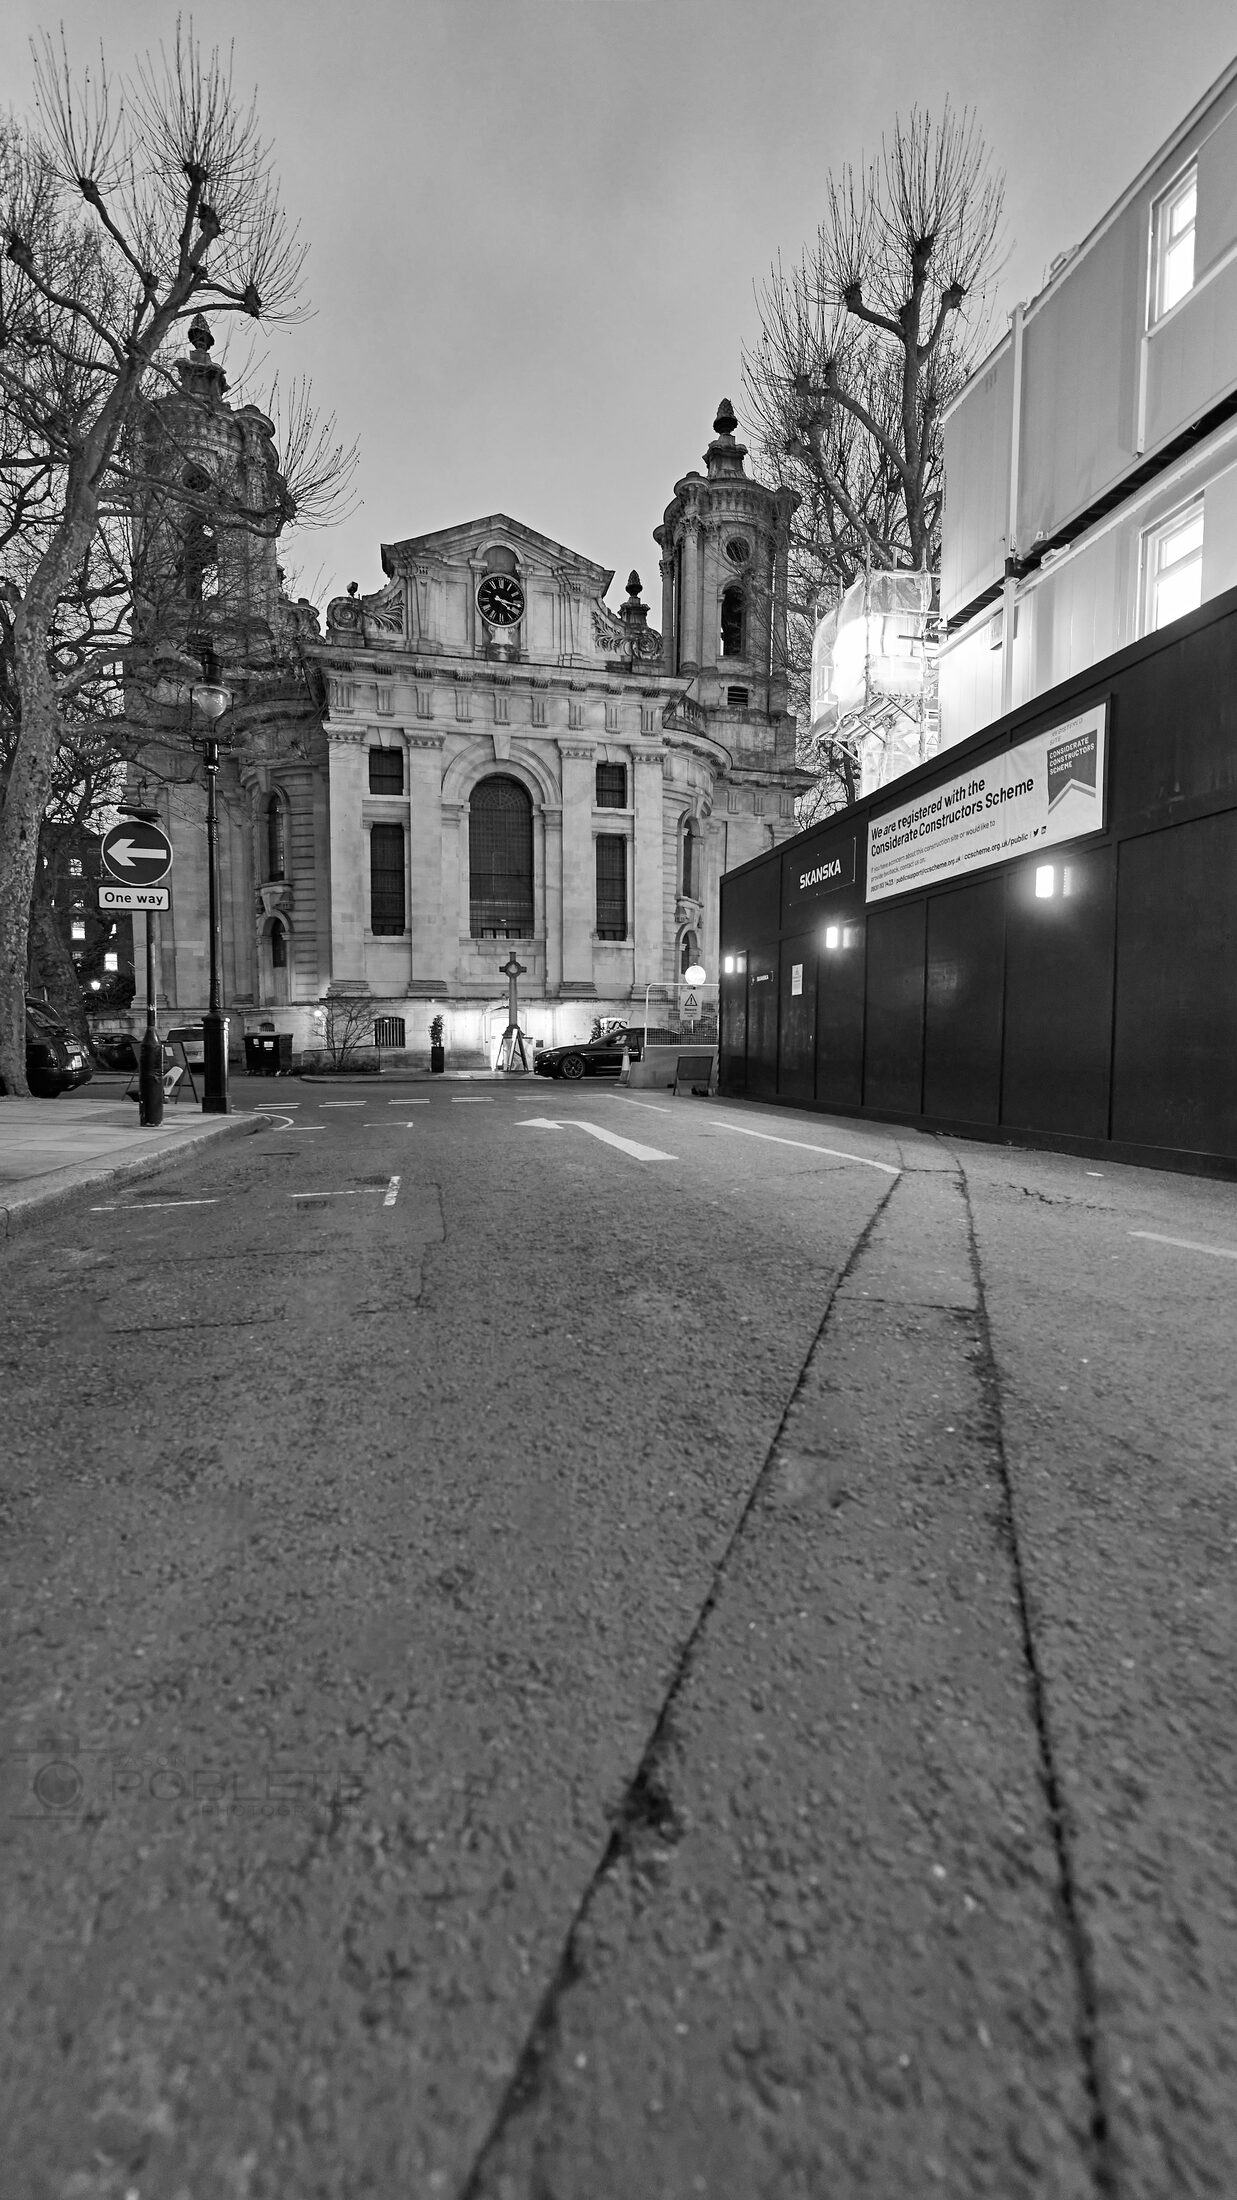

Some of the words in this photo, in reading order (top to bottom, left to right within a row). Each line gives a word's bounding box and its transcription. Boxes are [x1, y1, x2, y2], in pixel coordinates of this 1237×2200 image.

[1049, 736, 1089, 760] CONSIDERATE
[1049, 742, 1095, 767] CONSTRUCTORS
[1049, 760, 1073, 776] SCHEME
[871, 827, 882, 841] We
[883, 822, 897, 836] are
[897, 796, 943, 829] registered
[944, 786, 966, 808] with
[968, 779, 986, 797] the
[871, 828, 919, 857] Considerate
[919, 800, 983, 836] Constructors
[985, 778, 1034, 809] Scheme
[950, 832, 959, 844] site
[959, 831, 965, 840] or
[965, 823, 980, 837] would
[980, 821, 990, 831] like
[989, 819, 996, 828] to
[964, 833, 1029, 860] ccscheme.org.uk/public
[799, 859, 842, 889] SKANSKA
[104, 891, 132, 903] One
[136, 895, 164, 906] way
